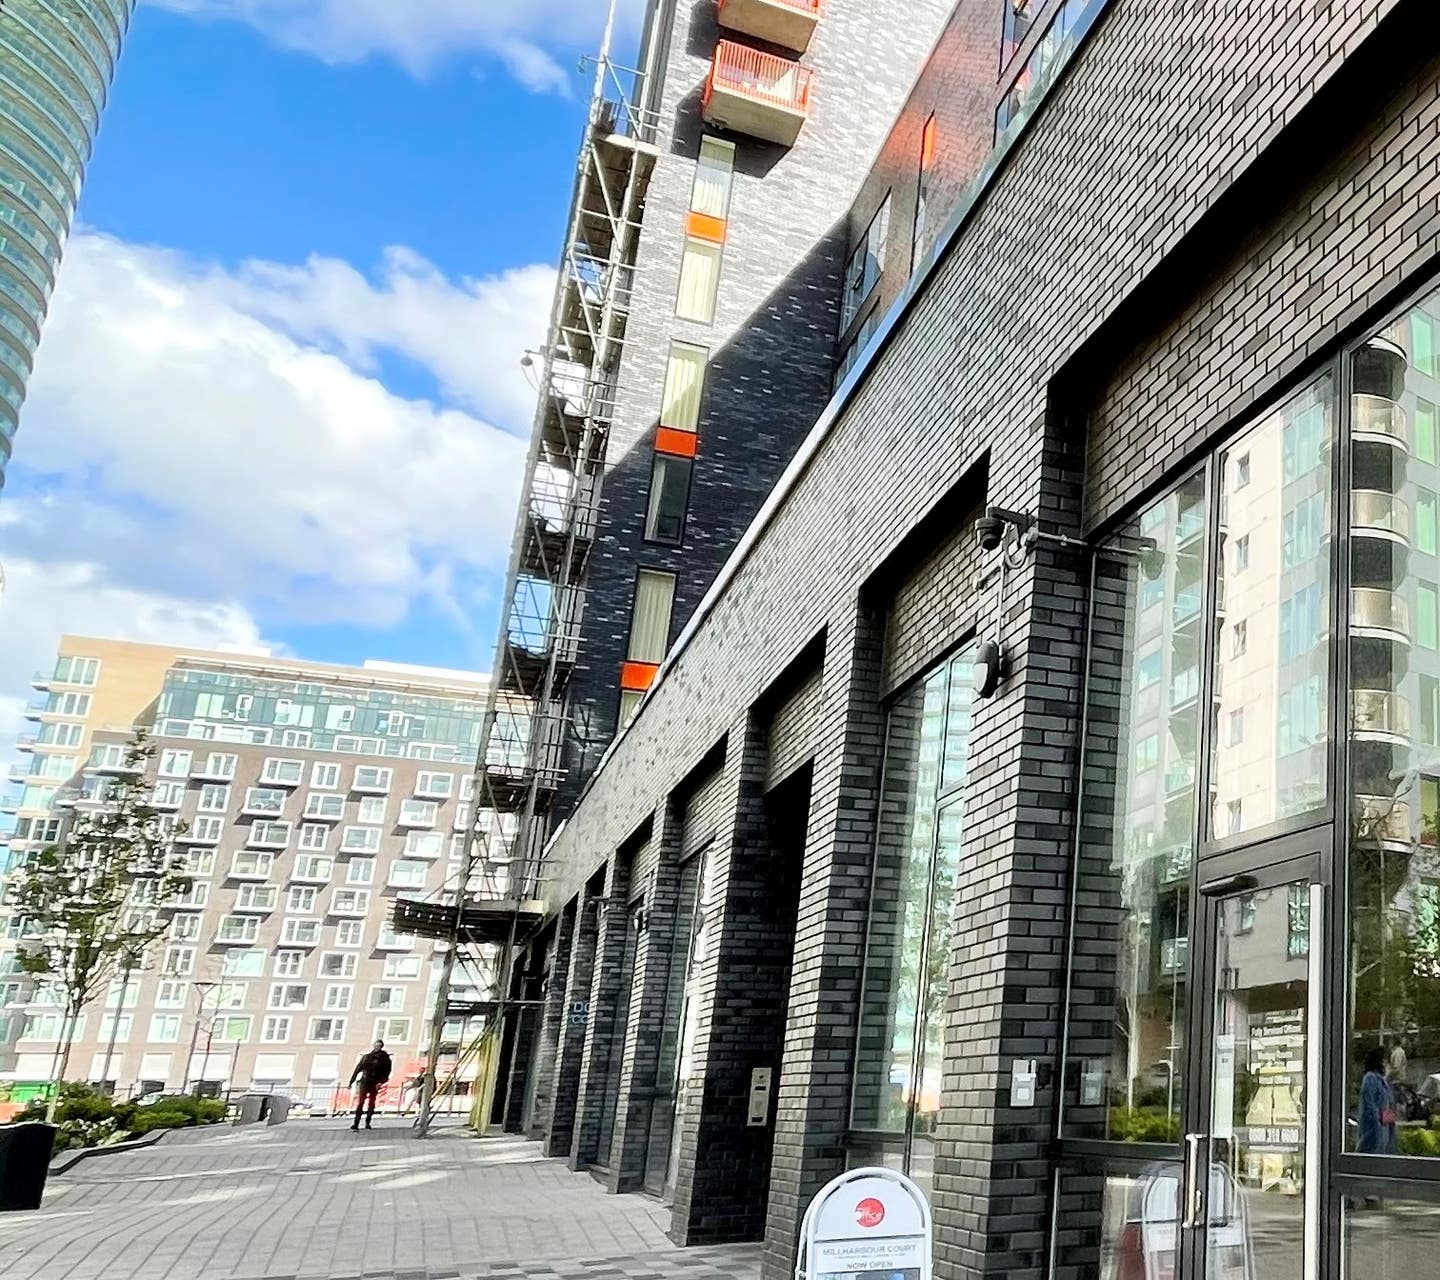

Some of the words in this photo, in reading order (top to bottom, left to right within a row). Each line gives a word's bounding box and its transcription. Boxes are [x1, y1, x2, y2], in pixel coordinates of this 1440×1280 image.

[823, 1246, 885, 1256] MILLHARBOUR
[887, 1244, 916, 1253] COURT
[847, 1261, 867, 1270] NOW
[869, 1261, 893, 1269] OPEN
